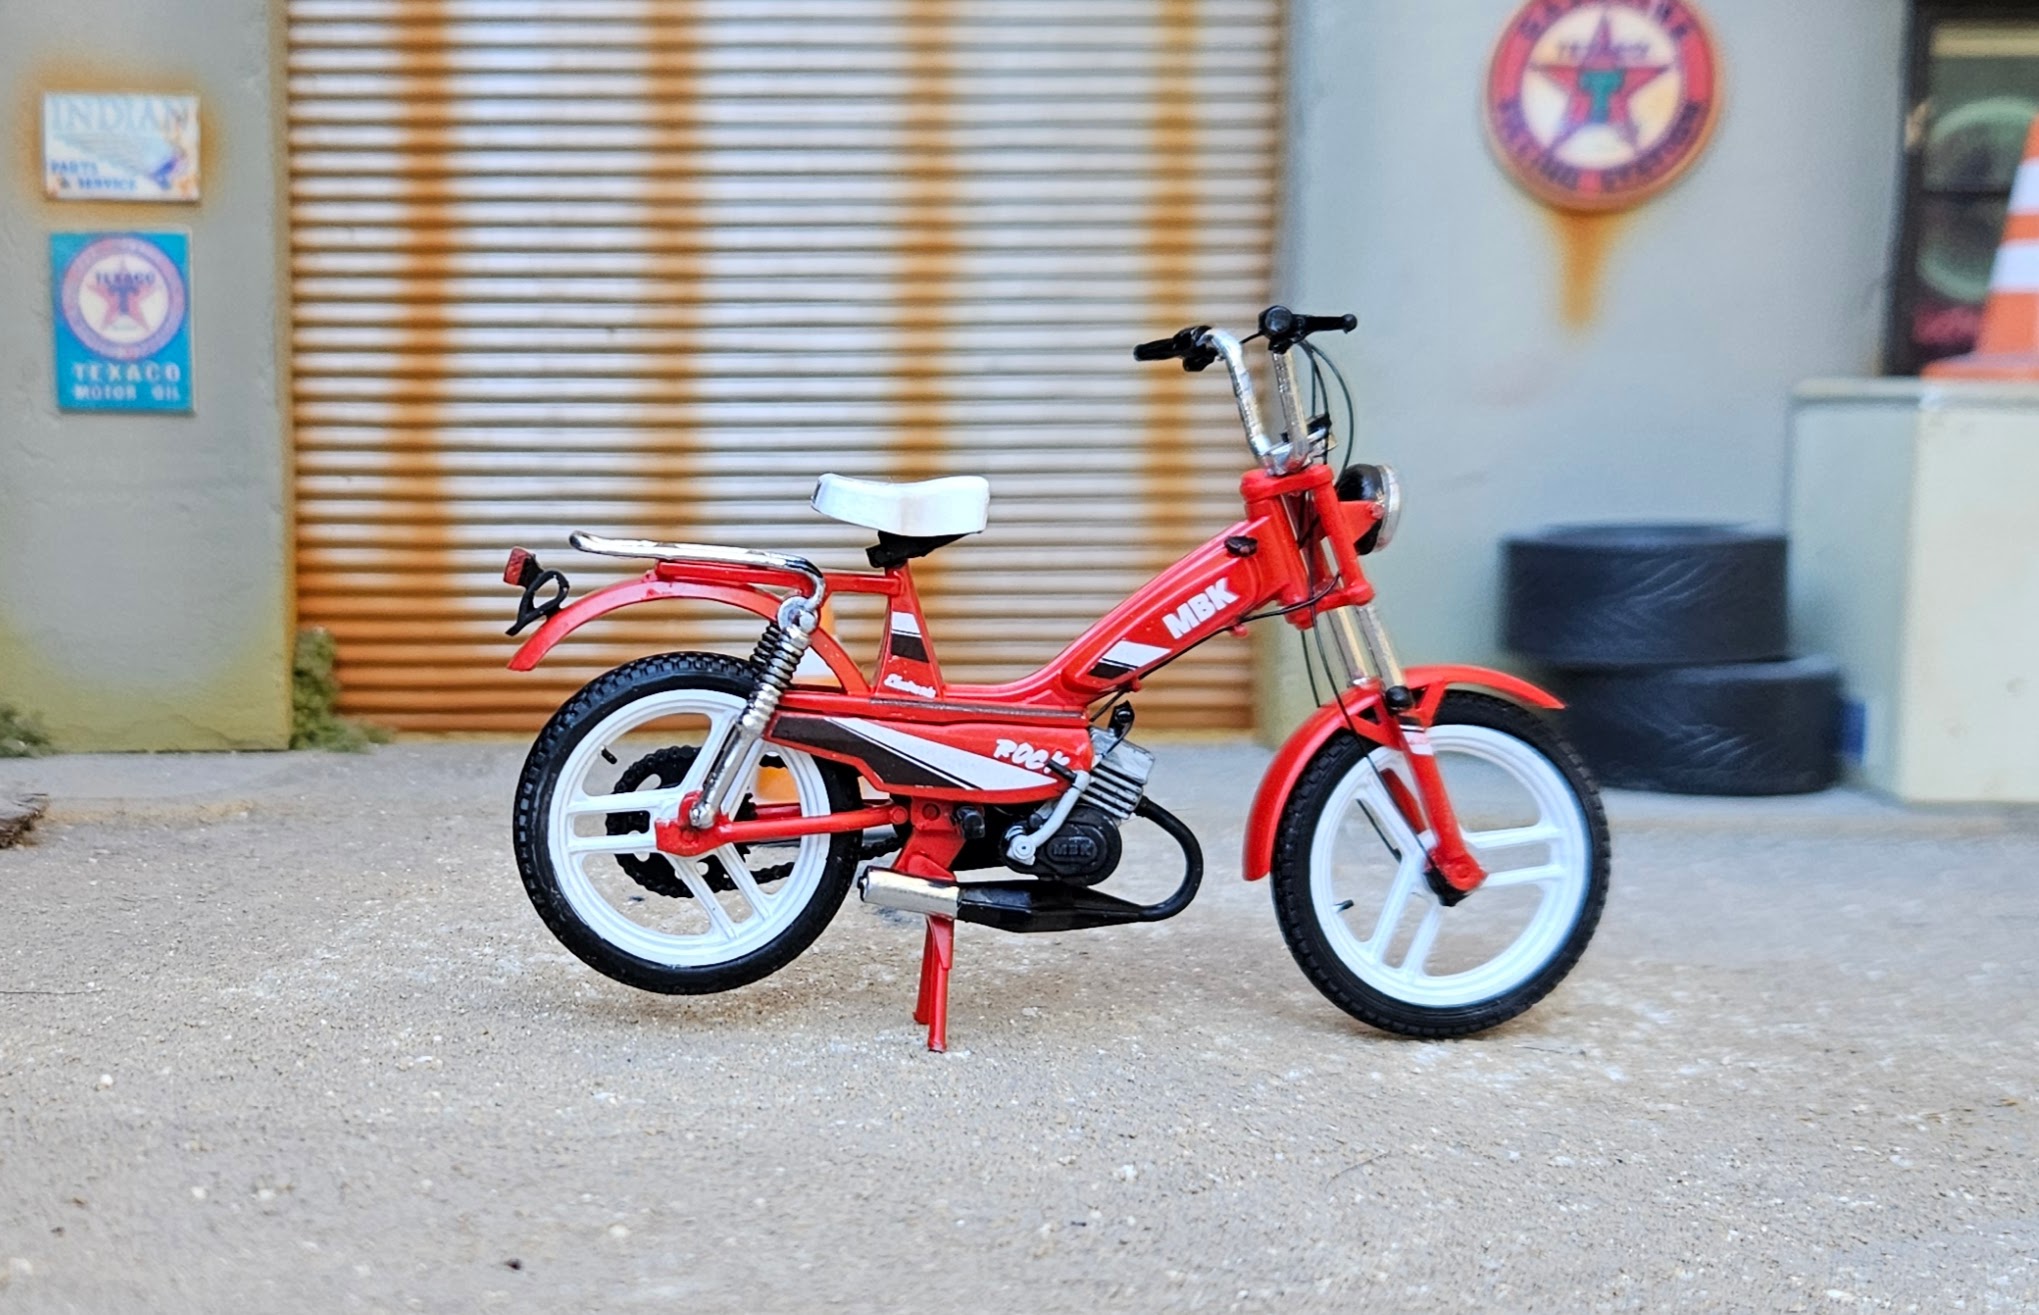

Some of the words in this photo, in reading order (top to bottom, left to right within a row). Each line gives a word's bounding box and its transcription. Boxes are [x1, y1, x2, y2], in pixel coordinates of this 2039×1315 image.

[51, 97, 190, 132] INDIAN
[78, 177, 137, 190] SERVICE
[73, 361, 181, 383] TEXACO
[73, 385, 137, 400] MOTOR
[151, 385, 181, 400] OIL
[1161, 577, 1240, 640] MBK
[1052, 842, 1092, 856] MBK
